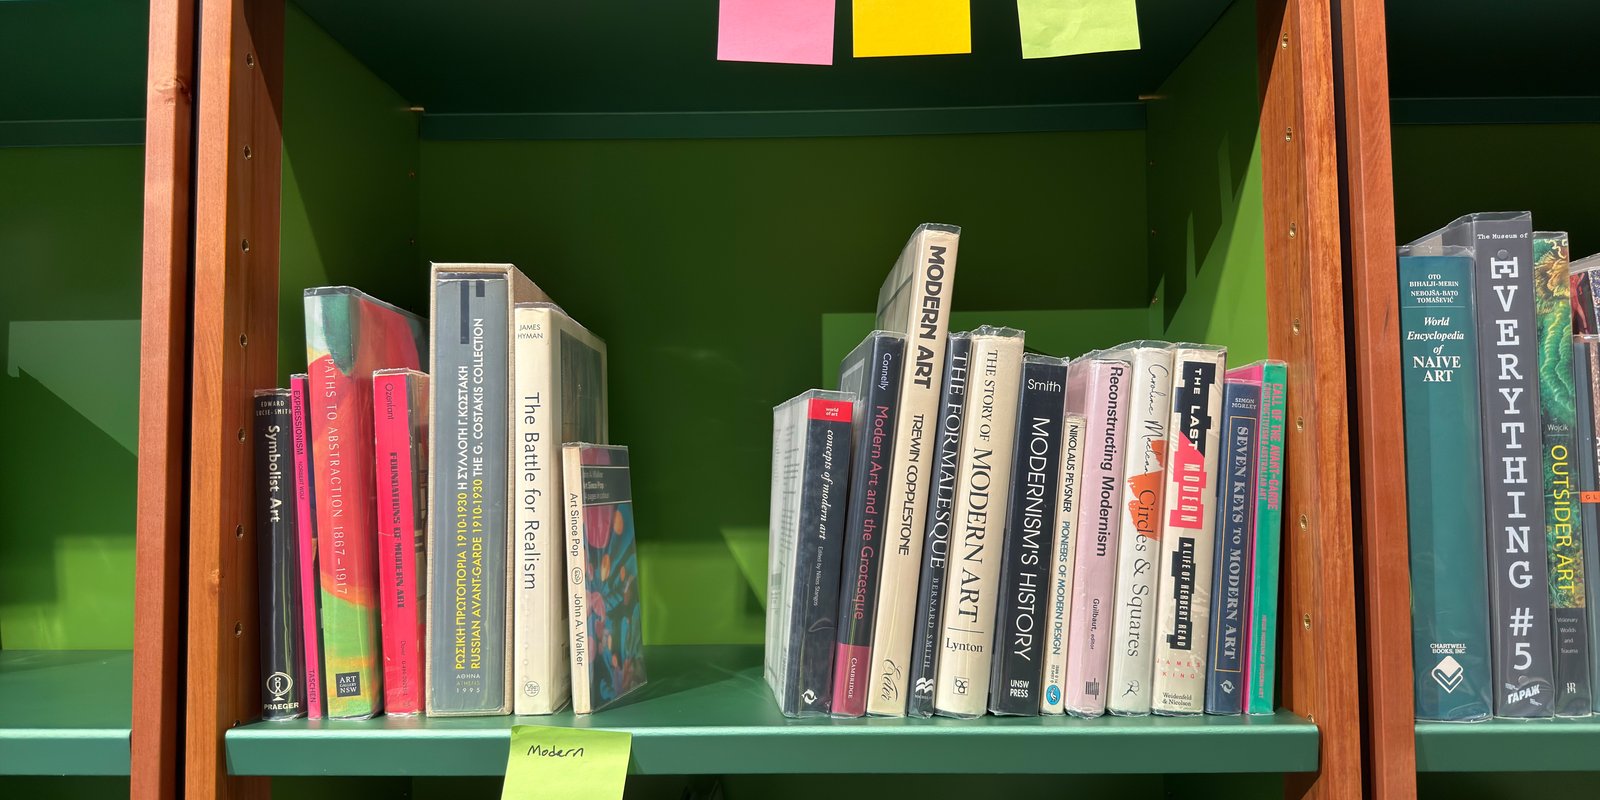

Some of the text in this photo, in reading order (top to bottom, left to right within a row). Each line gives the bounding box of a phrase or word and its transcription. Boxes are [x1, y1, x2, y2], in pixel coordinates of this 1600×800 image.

[914, 246, 946, 389] MODERN ART
[1407, 331, 1464, 342] Encyclopedia
[1424, 316, 1450, 326] World
[1413, 356, 1462, 369] NAIVE
[1432, 345, 1444, 356] of
[878, 353, 891, 390] Connelly
[1028, 379, 1061, 393] Smith
[1148, 364, 1168, 416] Caroline
[1423, 370, 1454, 382] ART
[473, 318, 484, 476] THE G. COSTAKIS COLLECTION
[1188, 368, 1202, 451] THE LAST
[294, 390, 303, 455] EXPRESSIONISM
[324, 358, 342, 517] PATHS TO ABSTRACTION
[1490, 256, 1532, 588] EVERYTHING
[458, 428, 468, 480] ΣΥΛΛΟΓΗ
[822, 429, 834, 470] concepts
[928, 352, 968, 569] THE FORMALESQUE
[1067, 425, 1078, 470] NIKOLAUS
[1096, 366, 1123, 556] Reconstructing Modernism
[1268, 383, 1283, 511] CALL OF THE AVANT-GARDE
[265, 426, 282, 522] Symbolist Art
[524, 392, 541, 590] The Battle for Realism
[820, 472, 833, 486] of
[898, 414, 924, 555] TREWIN COPPLESTONE
[958, 350, 998, 622] THE STORY OF MODERN ART
[1062, 473, 1074, 512] PEVSNER
[1181, 463, 1200, 522] MODERN
[820, 484, 832, 521] modern
[854, 406, 889, 620] Modern Art and the Grotesque
[1551, 445, 1575, 596] OUTSIDER ART
[1014, 418, 1050, 661] MODERNISM'S HISTORY
[1059, 521, 1071, 562] PIONEERS
[1181, 550, 1192, 568] LIFE
[1224, 427, 1248, 661] SEVEN KEYS TO MODERN ART
[456, 492, 468, 670] ΡΩΣΙΚΗ ΠΡΩΤΟΠΟΡΙΑ 1910-1930
[471, 479, 483, 670] RUSSIAN AVANT-GARDE 1910-1930
[570, 493, 584, 666] Art Since Pop John A. Walker
[1058, 565, 1067, 578] OF
[1126, 490, 1156, 657] Circles & Squares
[1181, 570, 1190, 581] OF
[1054, 579, 1066, 621] MODERN
[1091, 598, 1099, 632] Guilbaut,
[1179, 584, 1190, 621] HERBERT
[924, 577, 939, 668] BERNARD SMITH
[1053, 622, 1062, 655] DESIGN
[1177, 622, 1187, 647] READ
[946, 638, 983, 652] Lynton
[1156, 659, 1201, 668] JAMES
[848, 658, 857, 698] CAMBRIDGE
[1010, 680, 1029, 688] UNSW
[1010, 688, 1028, 697] PRESS
[1162, 692, 1192, 701] Weidenfeld
[1508, 684, 1540, 704] ГАРАЖ
[527, 745, 584, 758] Modern
